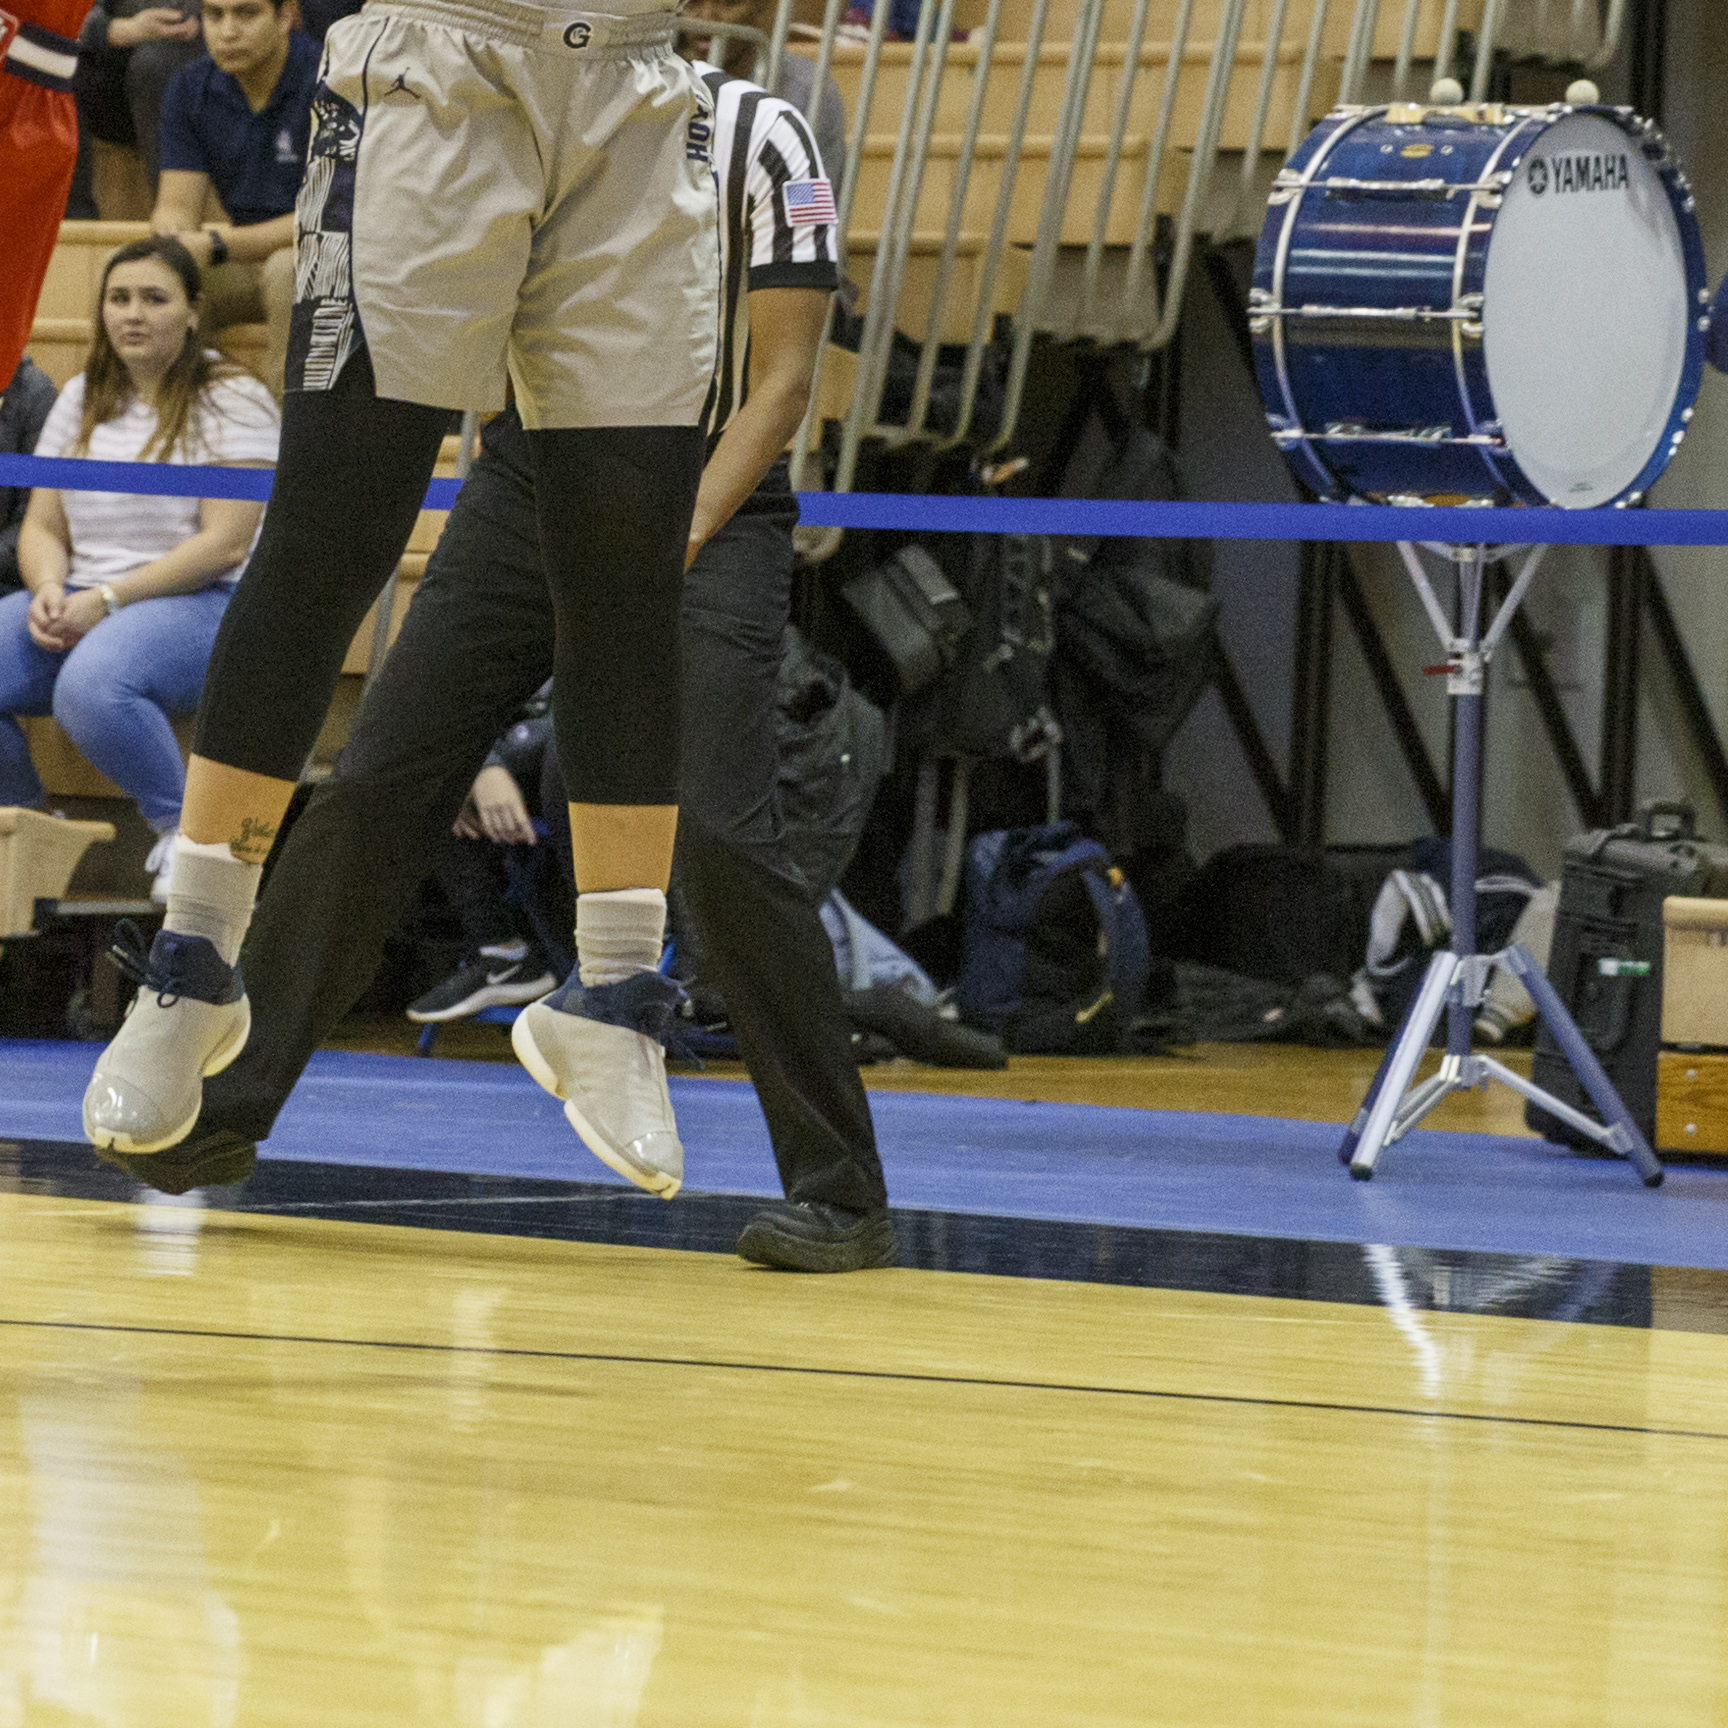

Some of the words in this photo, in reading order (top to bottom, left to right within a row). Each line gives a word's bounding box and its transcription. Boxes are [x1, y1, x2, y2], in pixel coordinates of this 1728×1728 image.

[562, 20, 592, 50] G
[685, 92, 711, 163] HOY
[1551, 154, 1630, 193] YAMAHA
